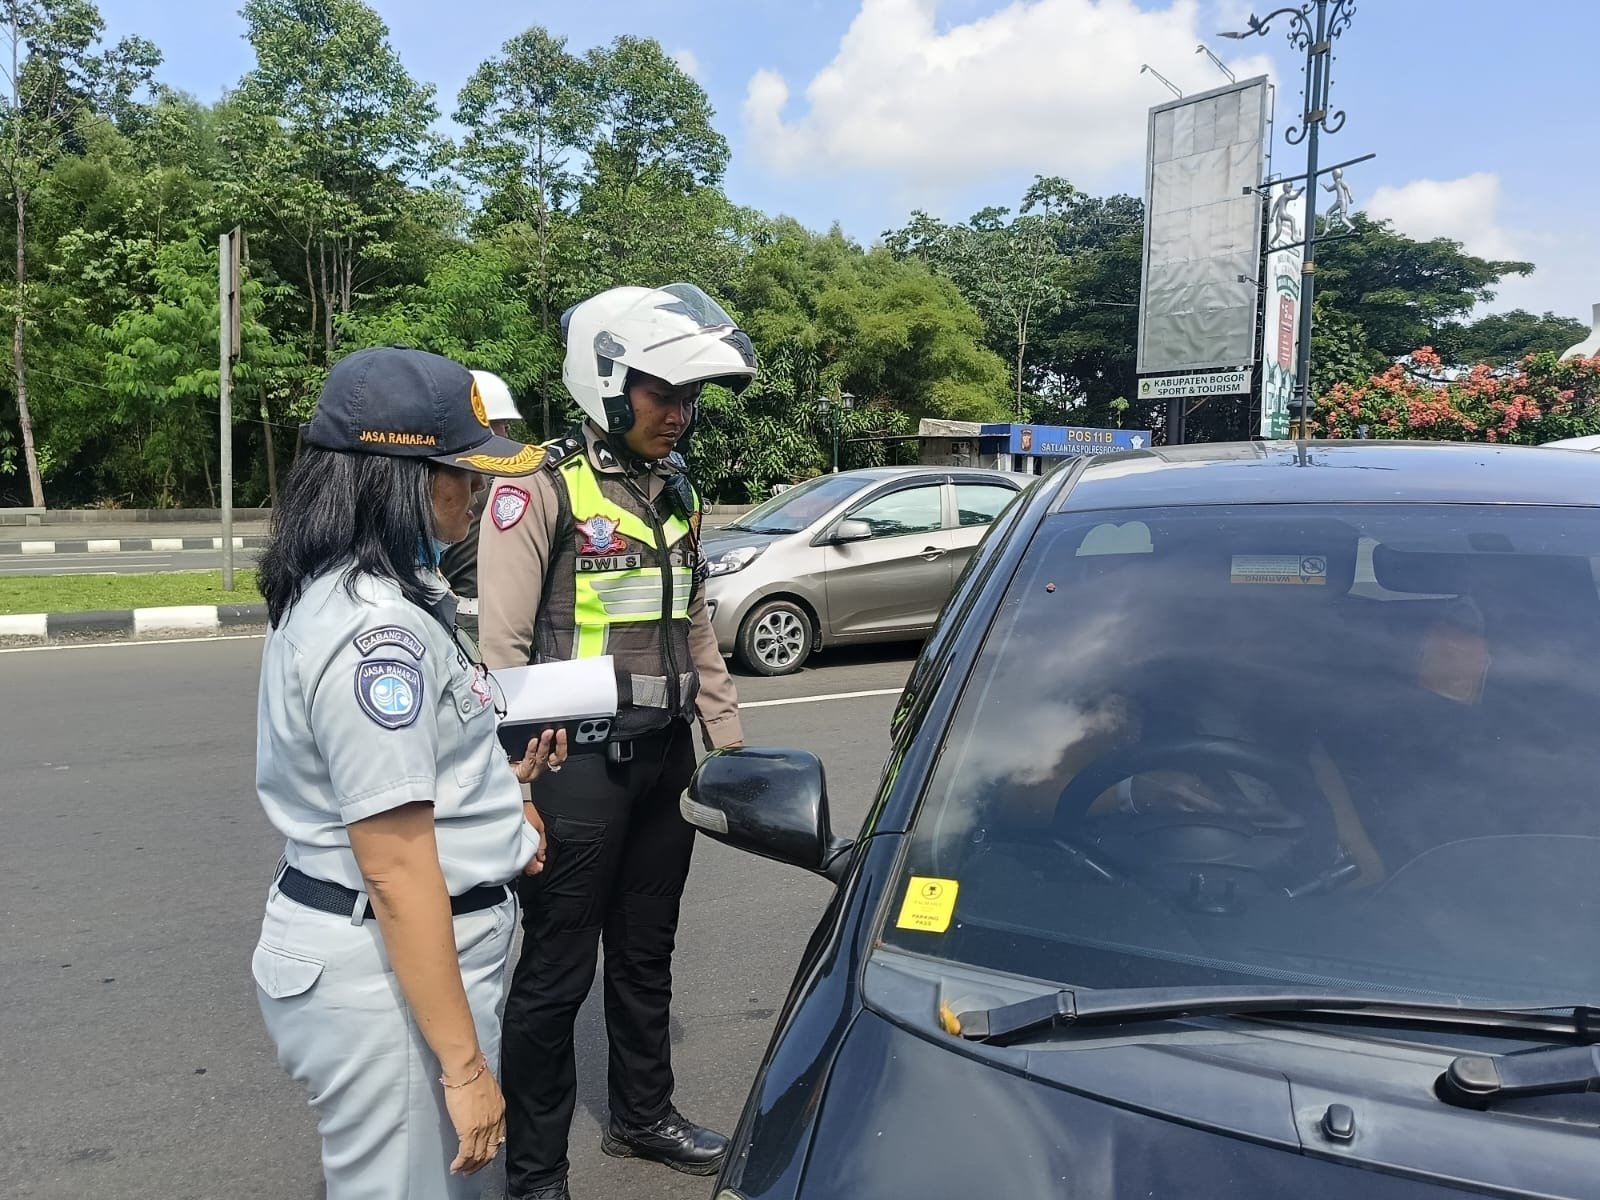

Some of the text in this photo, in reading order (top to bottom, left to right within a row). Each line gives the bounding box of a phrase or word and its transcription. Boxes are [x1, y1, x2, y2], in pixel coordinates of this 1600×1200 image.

[1154, 373, 1245, 388] KABUPATEN BOGOR
[1157, 383, 1241, 396] SPORT & TOURISM
[360, 430, 436, 446] JASA RAHARJA
[1068, 430, 1113, 443] POS 11 B
[580, 555, 637, 571] DWI S
[1245, 575, 1290, 584] WARNING
[362, 631, 421, 654] CABANG BALI
[363, 665, 417, 685] JASA RAHARJA
